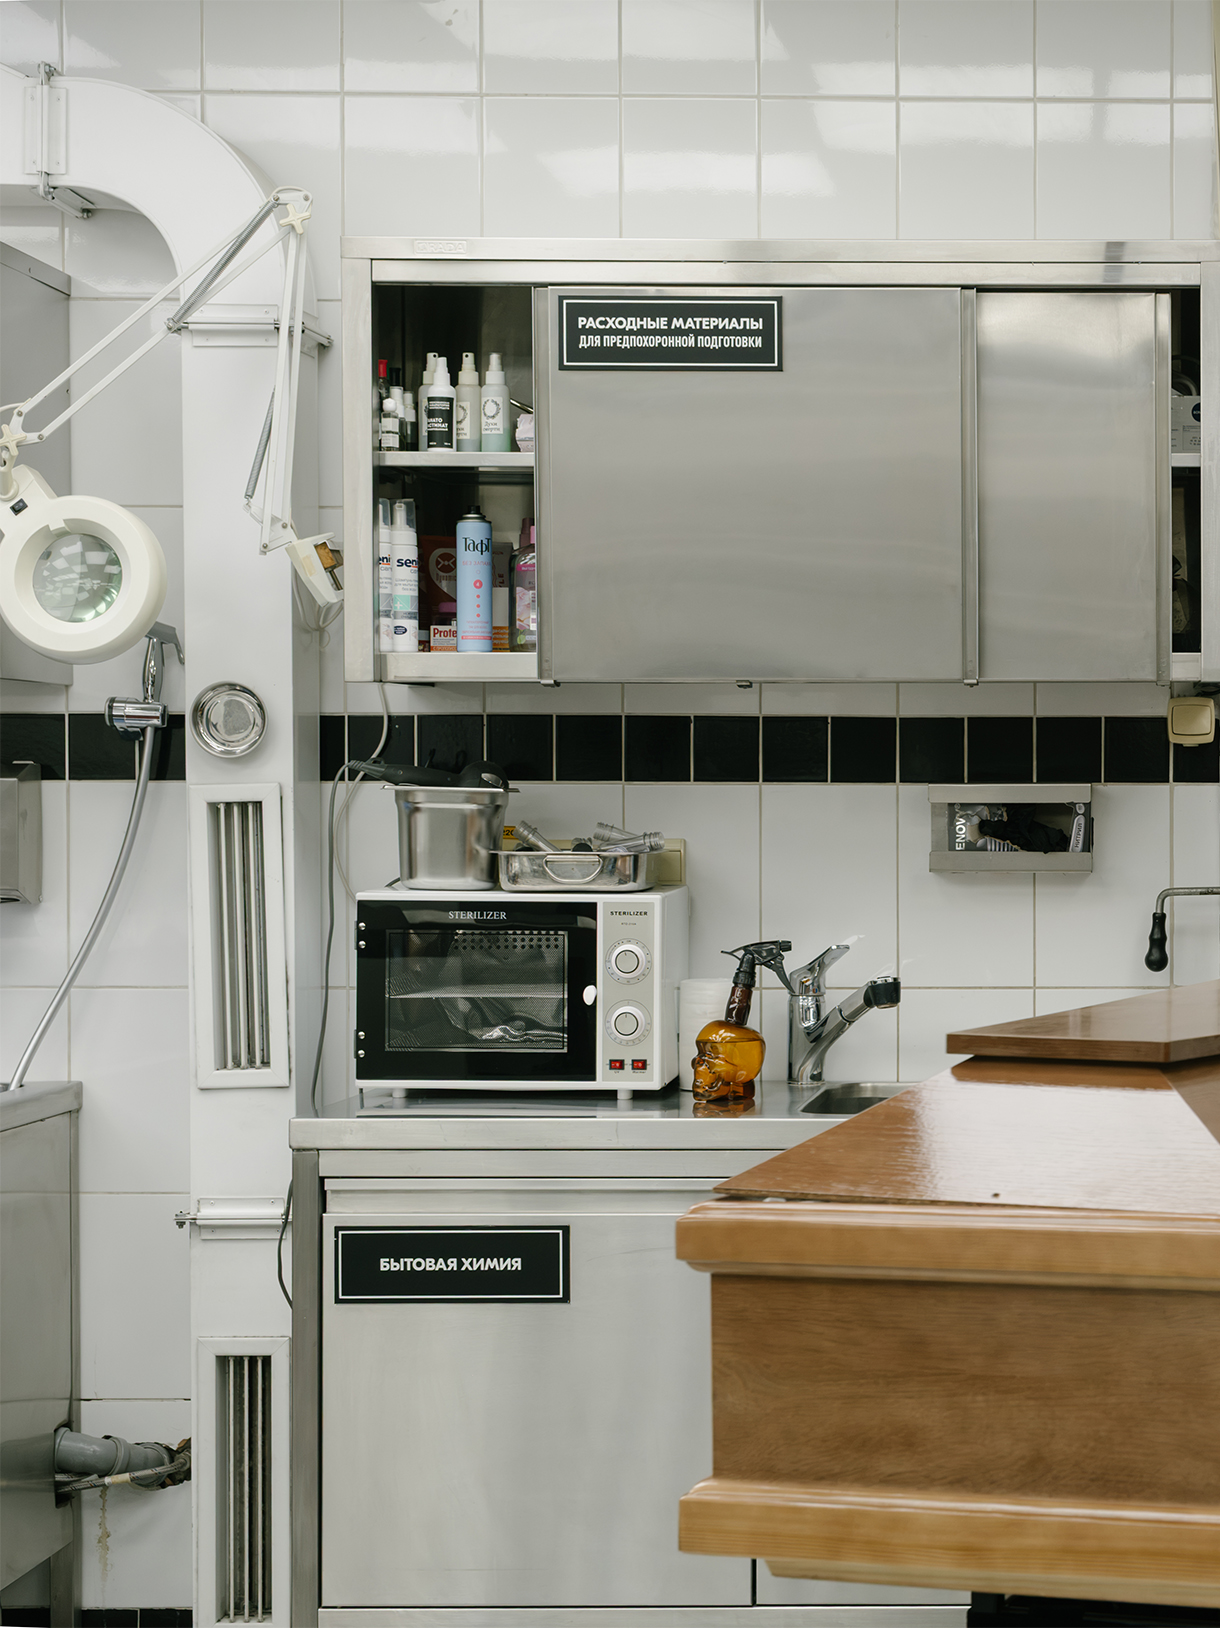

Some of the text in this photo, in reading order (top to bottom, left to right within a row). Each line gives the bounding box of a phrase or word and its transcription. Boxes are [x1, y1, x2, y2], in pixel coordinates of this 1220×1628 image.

[578, 317, 763, 331] РАСХОДНЫЕ МАТЕРИАЛЫ
[579, 334, 762, 349] ДЛЯ ПРЕДПОХОРОННОЙ ПОДГОТОВКИ
[462, 537, 491, 555] Тафт
[396, 558, 418, 567] sen
[448, 911, 507, 919] STERILIZER
[380, 1258, 522, 1271] БЫТОВАЯ ХИМИЯ
